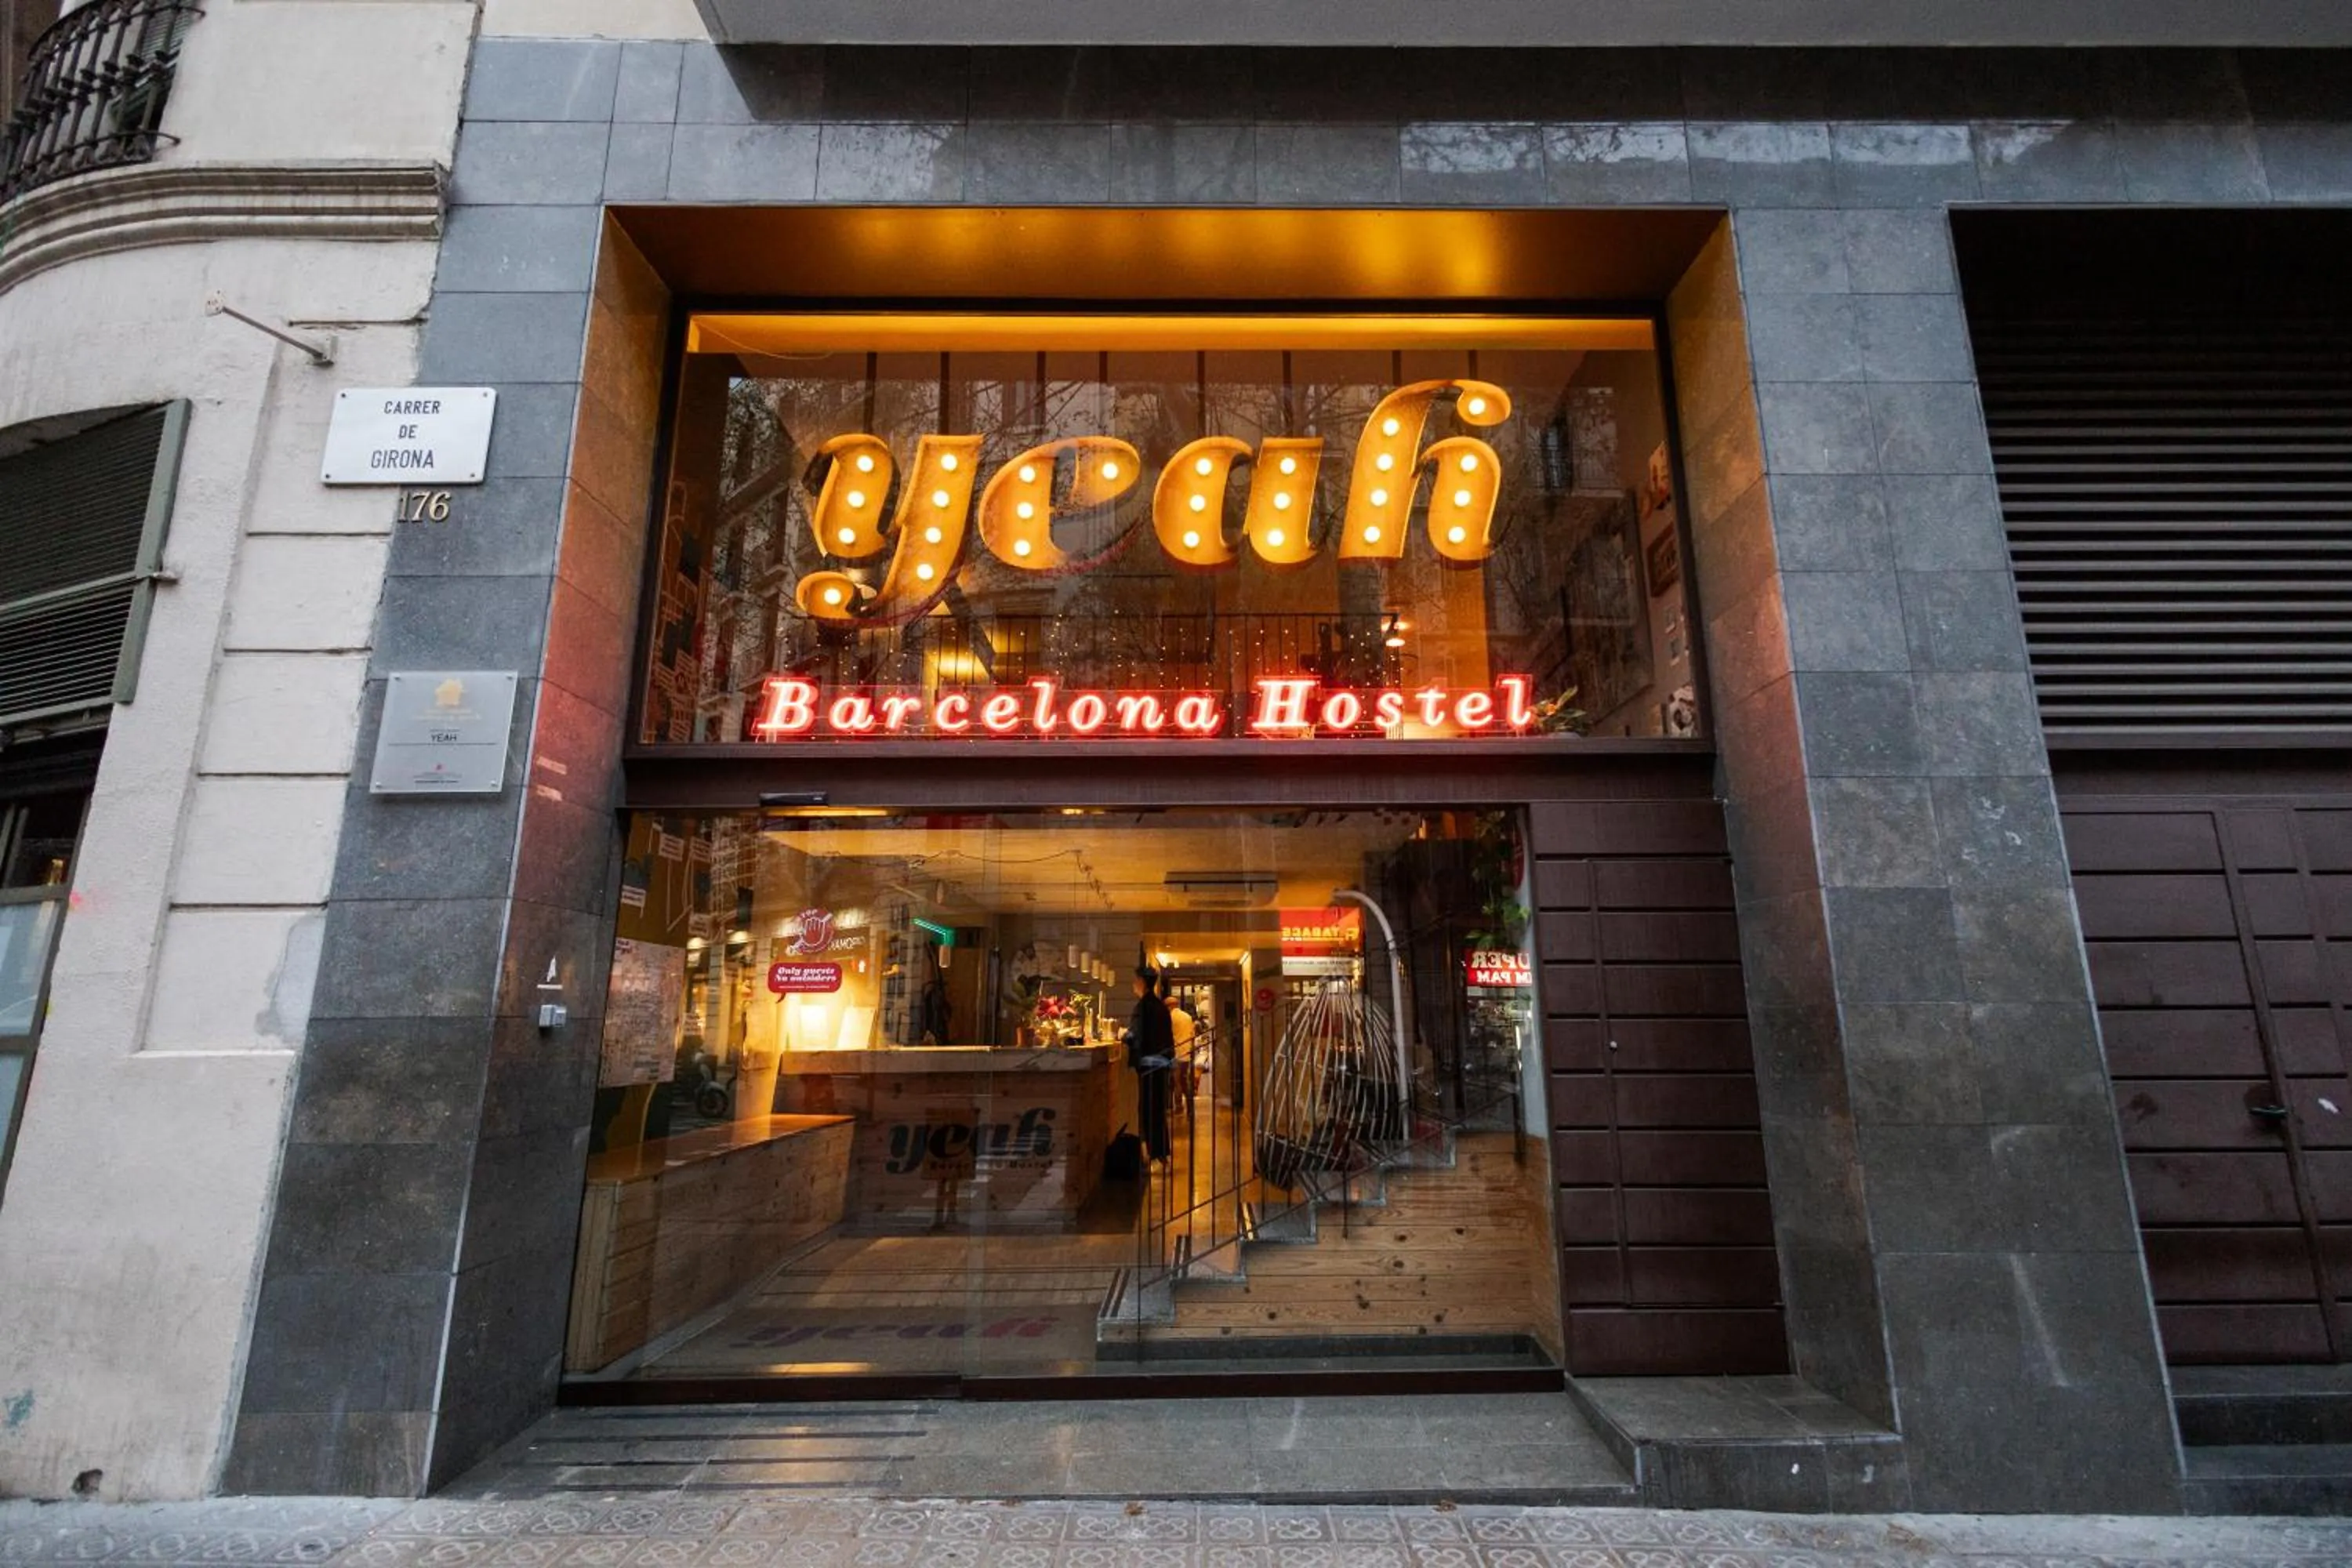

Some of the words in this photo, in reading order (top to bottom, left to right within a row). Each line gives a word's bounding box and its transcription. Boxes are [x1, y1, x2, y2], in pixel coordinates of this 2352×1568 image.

[383, 401, 441, 415] CARRER
[398, 425, 417, 439] DE
[371, 449, 434, 469] GIRONA
[397, 491, 452, 523] 176
[797, 379, 1512, 626] yeah
[756, 678, 1220, 732] Barcelona
[1252, 678, 1534, 731] Hostel
[430, 733, 458, 742] YEAH
[777, 967, 801, 976] Only
